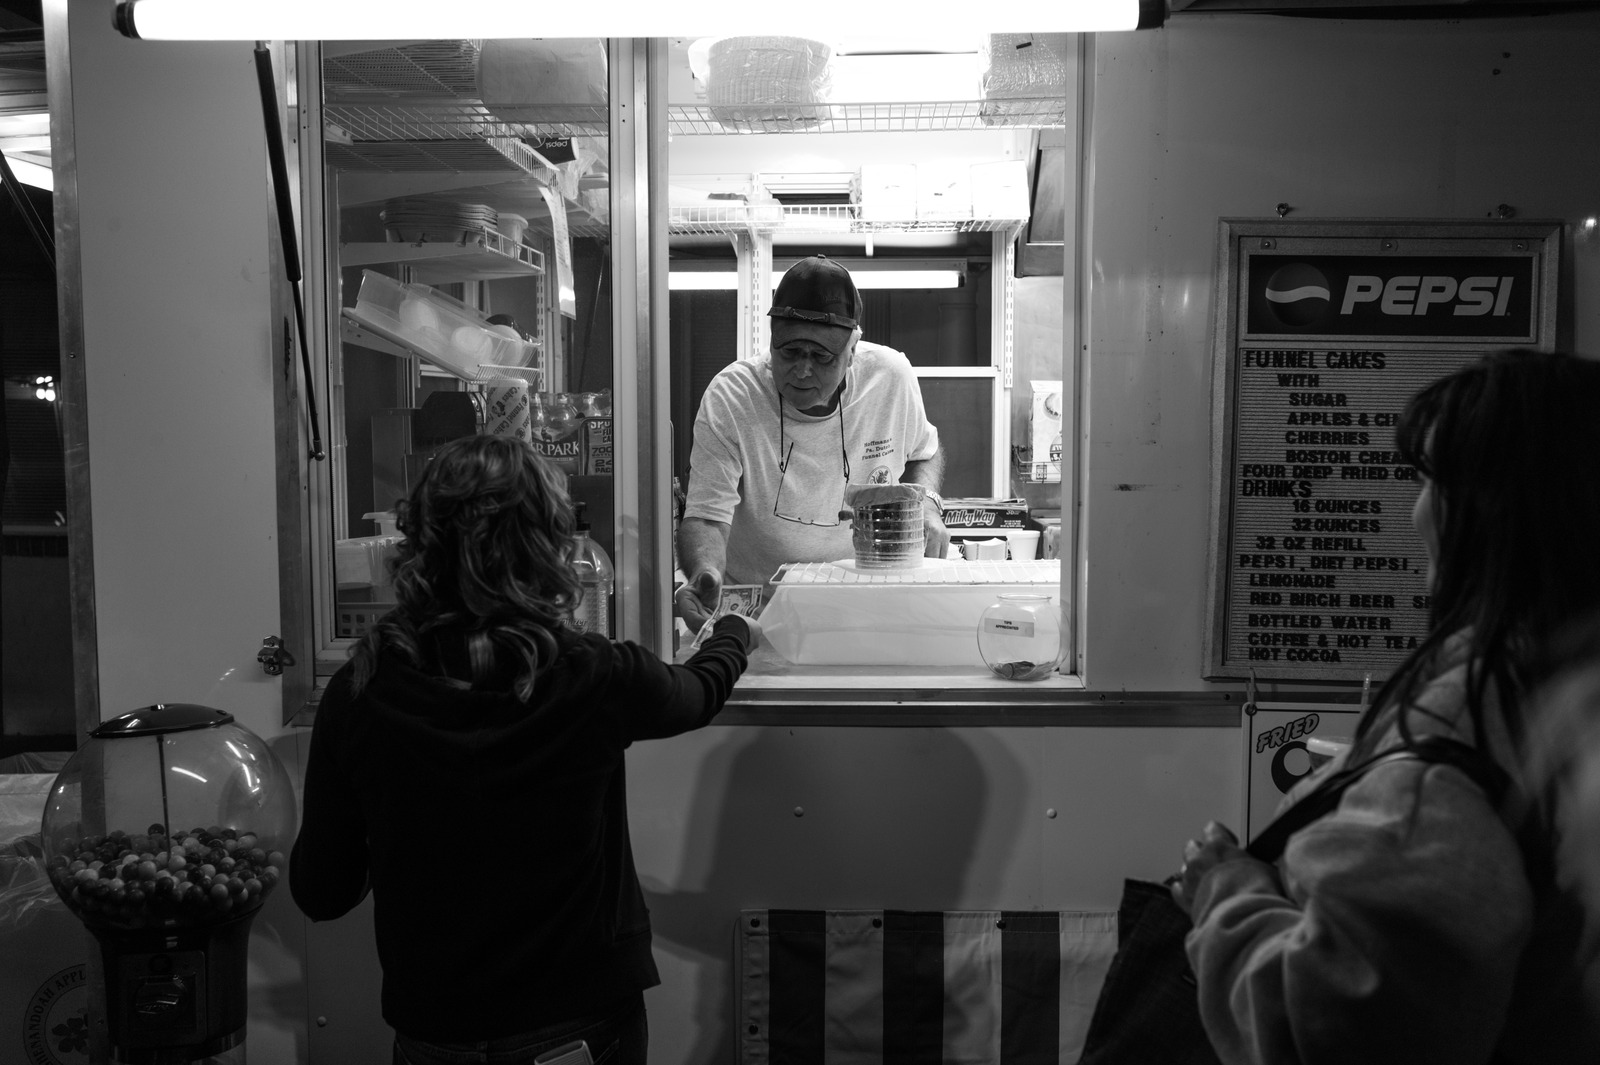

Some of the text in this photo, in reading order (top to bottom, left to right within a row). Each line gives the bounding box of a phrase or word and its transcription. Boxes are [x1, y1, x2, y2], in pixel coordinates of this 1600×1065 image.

[545, 140, 568, 149] pepsi
[1340, 275, 1514, 317] PEPSI
[1245, 350, 1386, 369] FUNNEL CAKES
[1277, 373, 1320, 387] WITH
[1289, 393, 1347, 407] SUGAR
[1287, 412, 1352, 426] APPLES
[1358, 412, 1369, 427] &
[1285, 431, 1369, 445] CHERRIES
[547, 440, 579, 456] PARK
[1286, 449, 1350, 463] BOSTON
[1242, 464, 1286, 478] FOUR
[1292, 465, 1333, 479] DEEP
[1341, 466, 1389, 480] FRIED
[1242, 479, 1313, 498] DRINKS
[1292, 499, 1382, 514] 16 OUNCES
[1292, 518, 1381, 533] 32 OUNCES
[1255, 536, 1367, 551] 32 OZ REFILL
[1311, 555, 1346, 570] DIET
[1250, 573, 1336, 588] LEMONADE
[1250, 592, 1282, 606] RED
[1289, 592, 1341, 607] BIRCH
[1350, 594, 1395, 608] BEER
[1248, 613, 1391, 630] BOTTLED WATER
[1248, 632, 1418, 649] COFFEE & HOT TEA
[1249, 647, 1342, 663] HOT COCOA
[1256, 713, 1320, 754] FRIED
